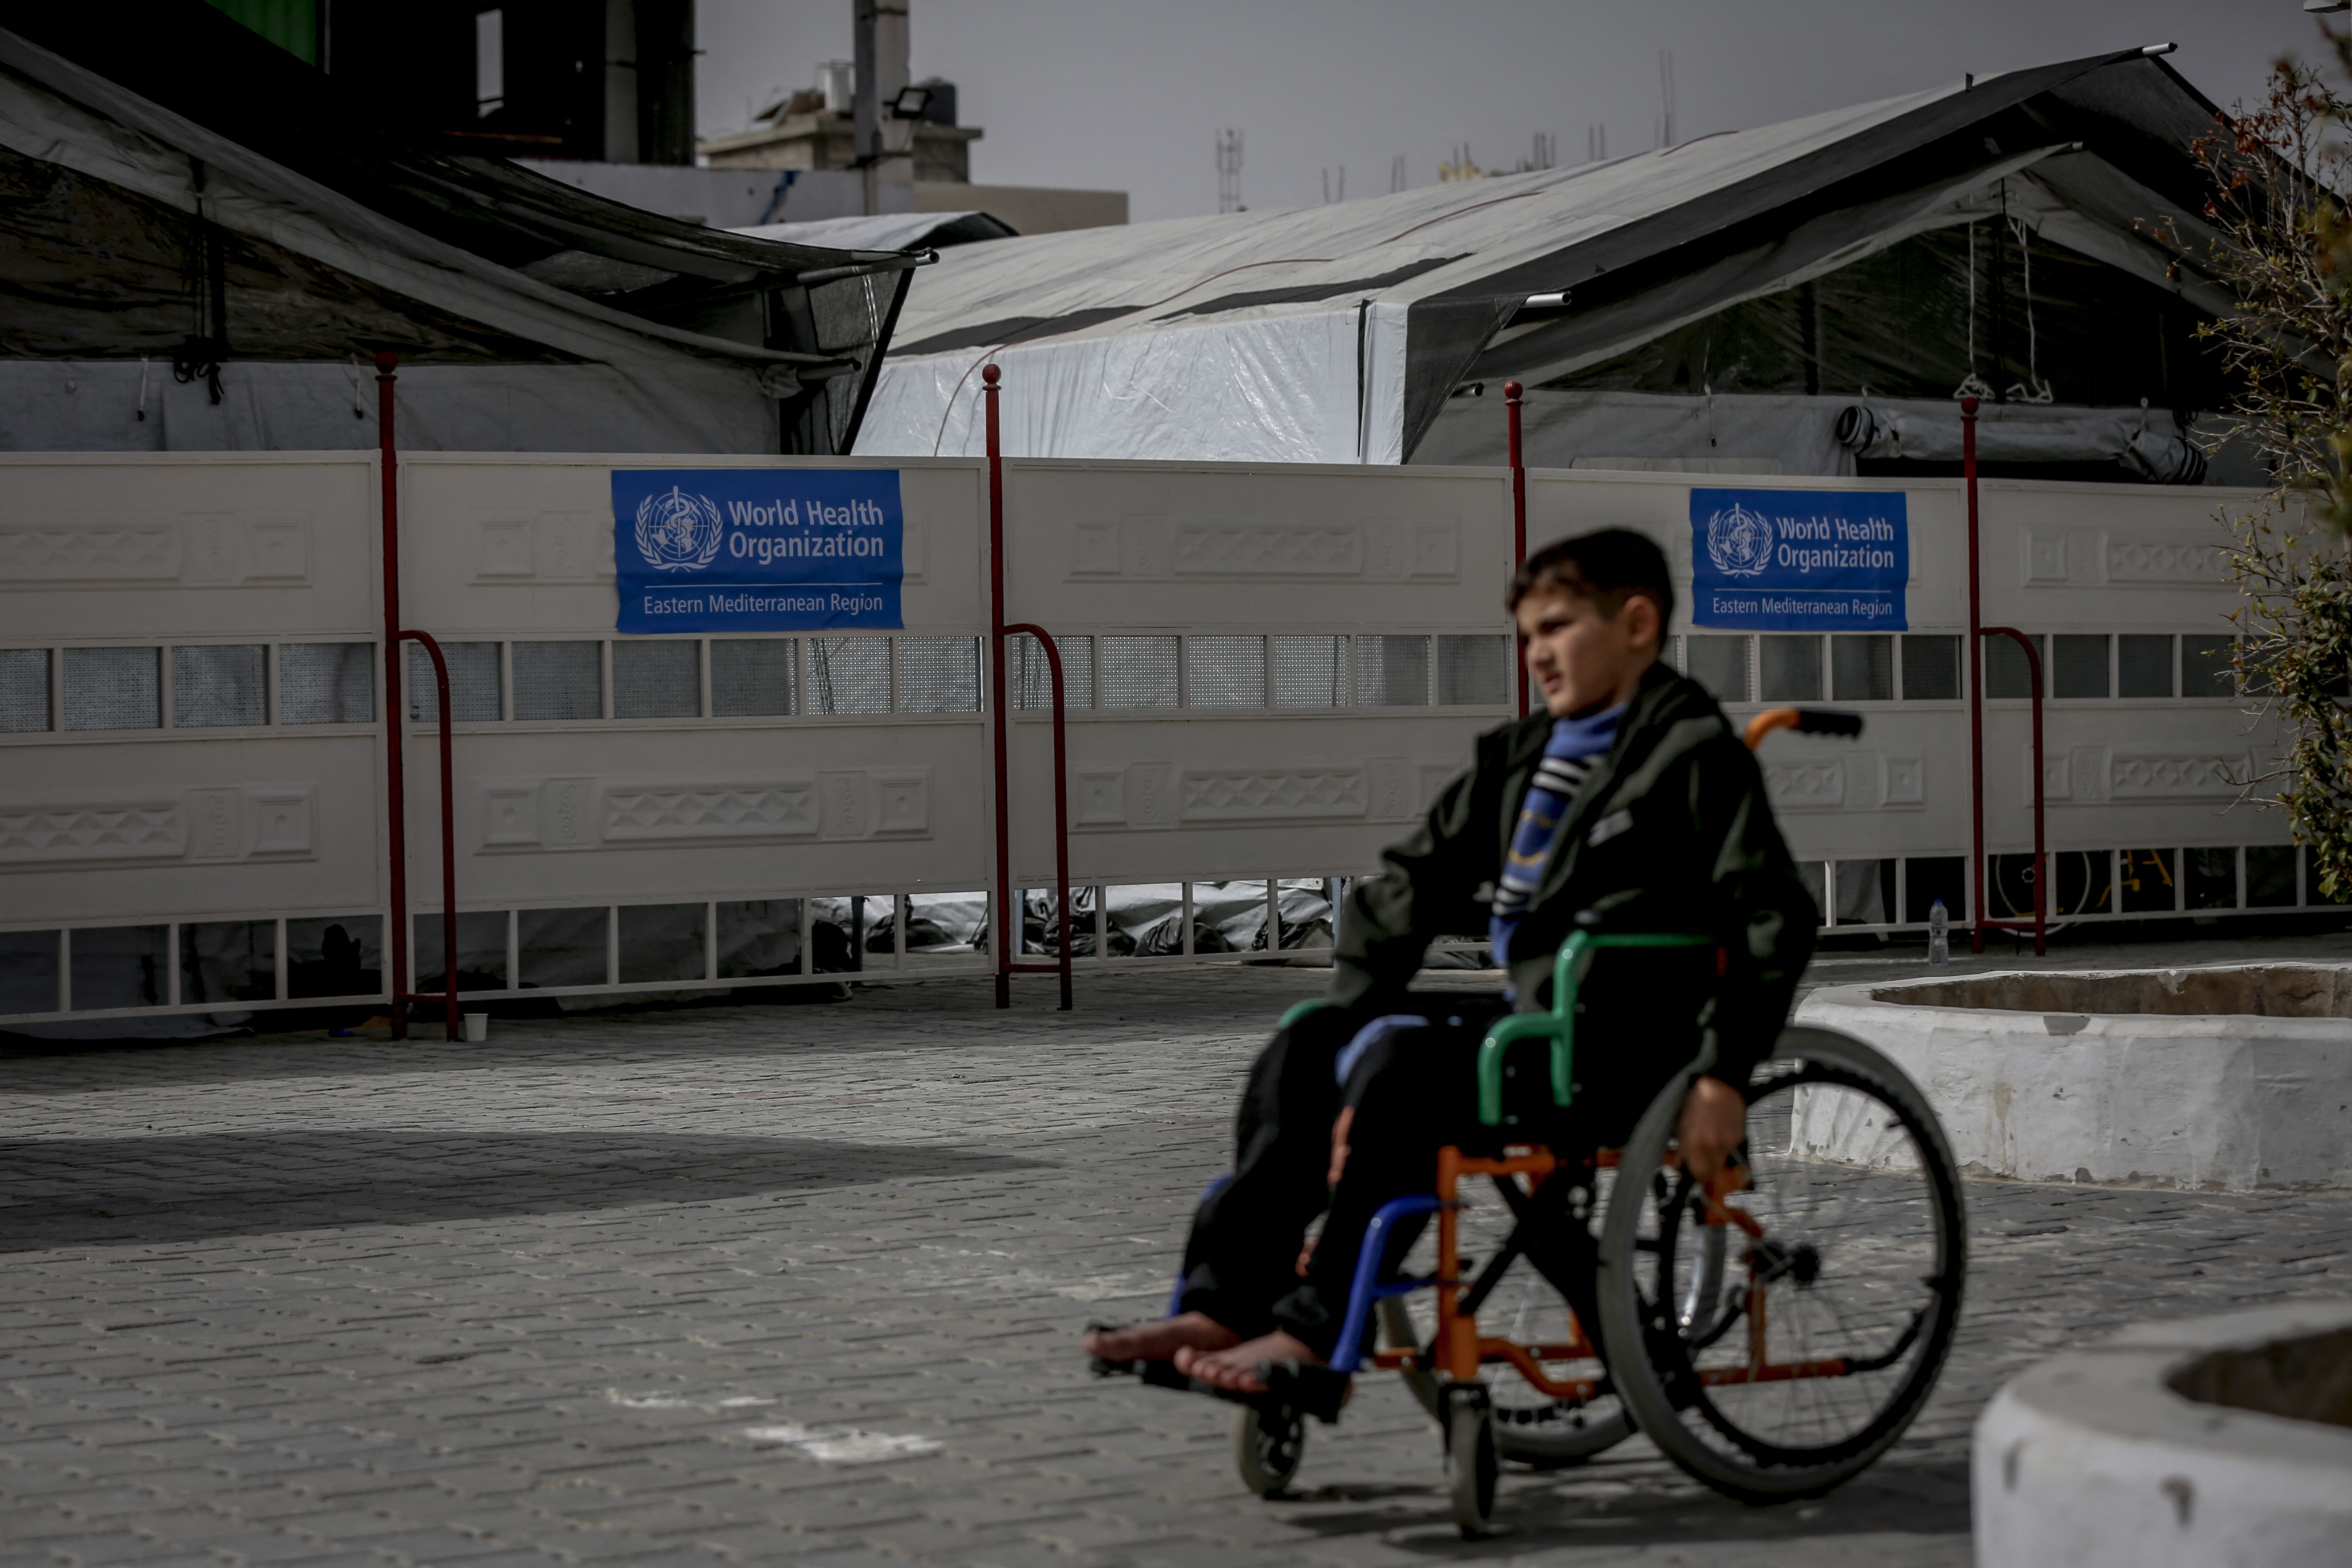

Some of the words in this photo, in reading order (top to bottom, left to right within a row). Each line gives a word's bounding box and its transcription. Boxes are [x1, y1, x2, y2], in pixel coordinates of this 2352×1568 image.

[728, 499, 799, 526] World
[806, 499, 883, 526] Health
[1775, 516, 1830, 540] World
[1835, 517, 1893, 541] Health
[729, 530, 883, 565] Organization
[1777, 543, 1894, 573] Organization
[644, 596, 703, 614] Eastern
[709, 593, 824, 612] Mediterranean
[831, 593, 882, 615] Region
[1713, 597, 1757, 613] Eastern
[1762, 597, 1849, 615] Mediterranean
[1853, 599, 1892, 619] Region
